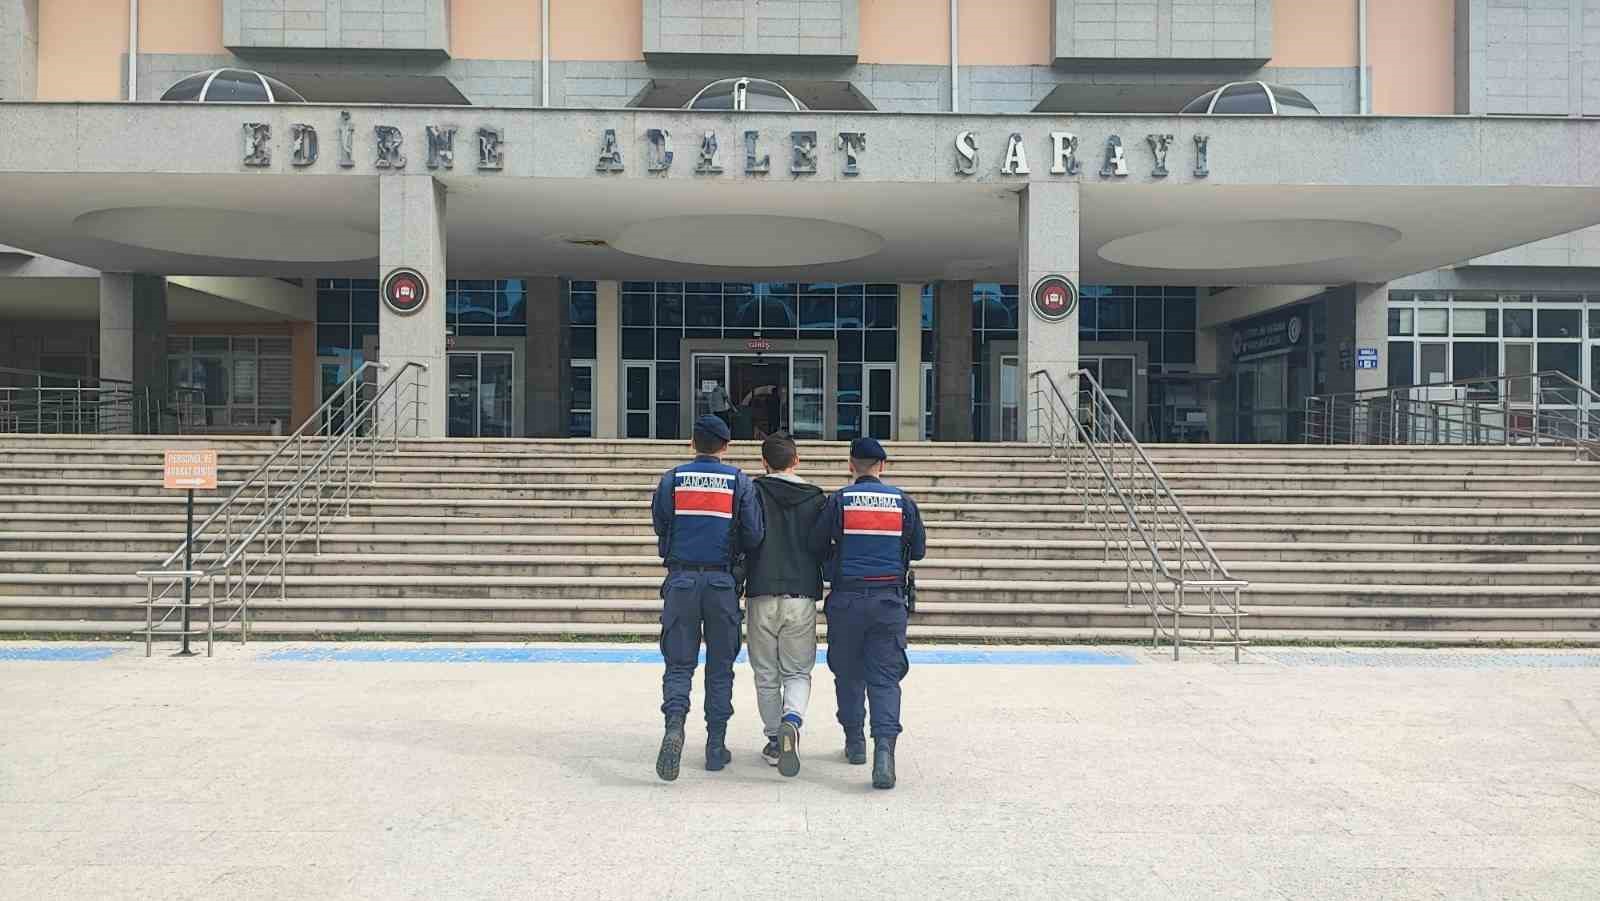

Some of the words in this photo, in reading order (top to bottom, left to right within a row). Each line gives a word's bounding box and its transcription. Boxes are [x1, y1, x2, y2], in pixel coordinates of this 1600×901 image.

[243, 110, 505, 170] EDİRNE
[595, 128, 867, 176] ADALET
[954, 131, 1210, 177] SARAYI
[680, 475, 729, 489] JANDARMA
[850, 495, 898, 508] JANDARMA
